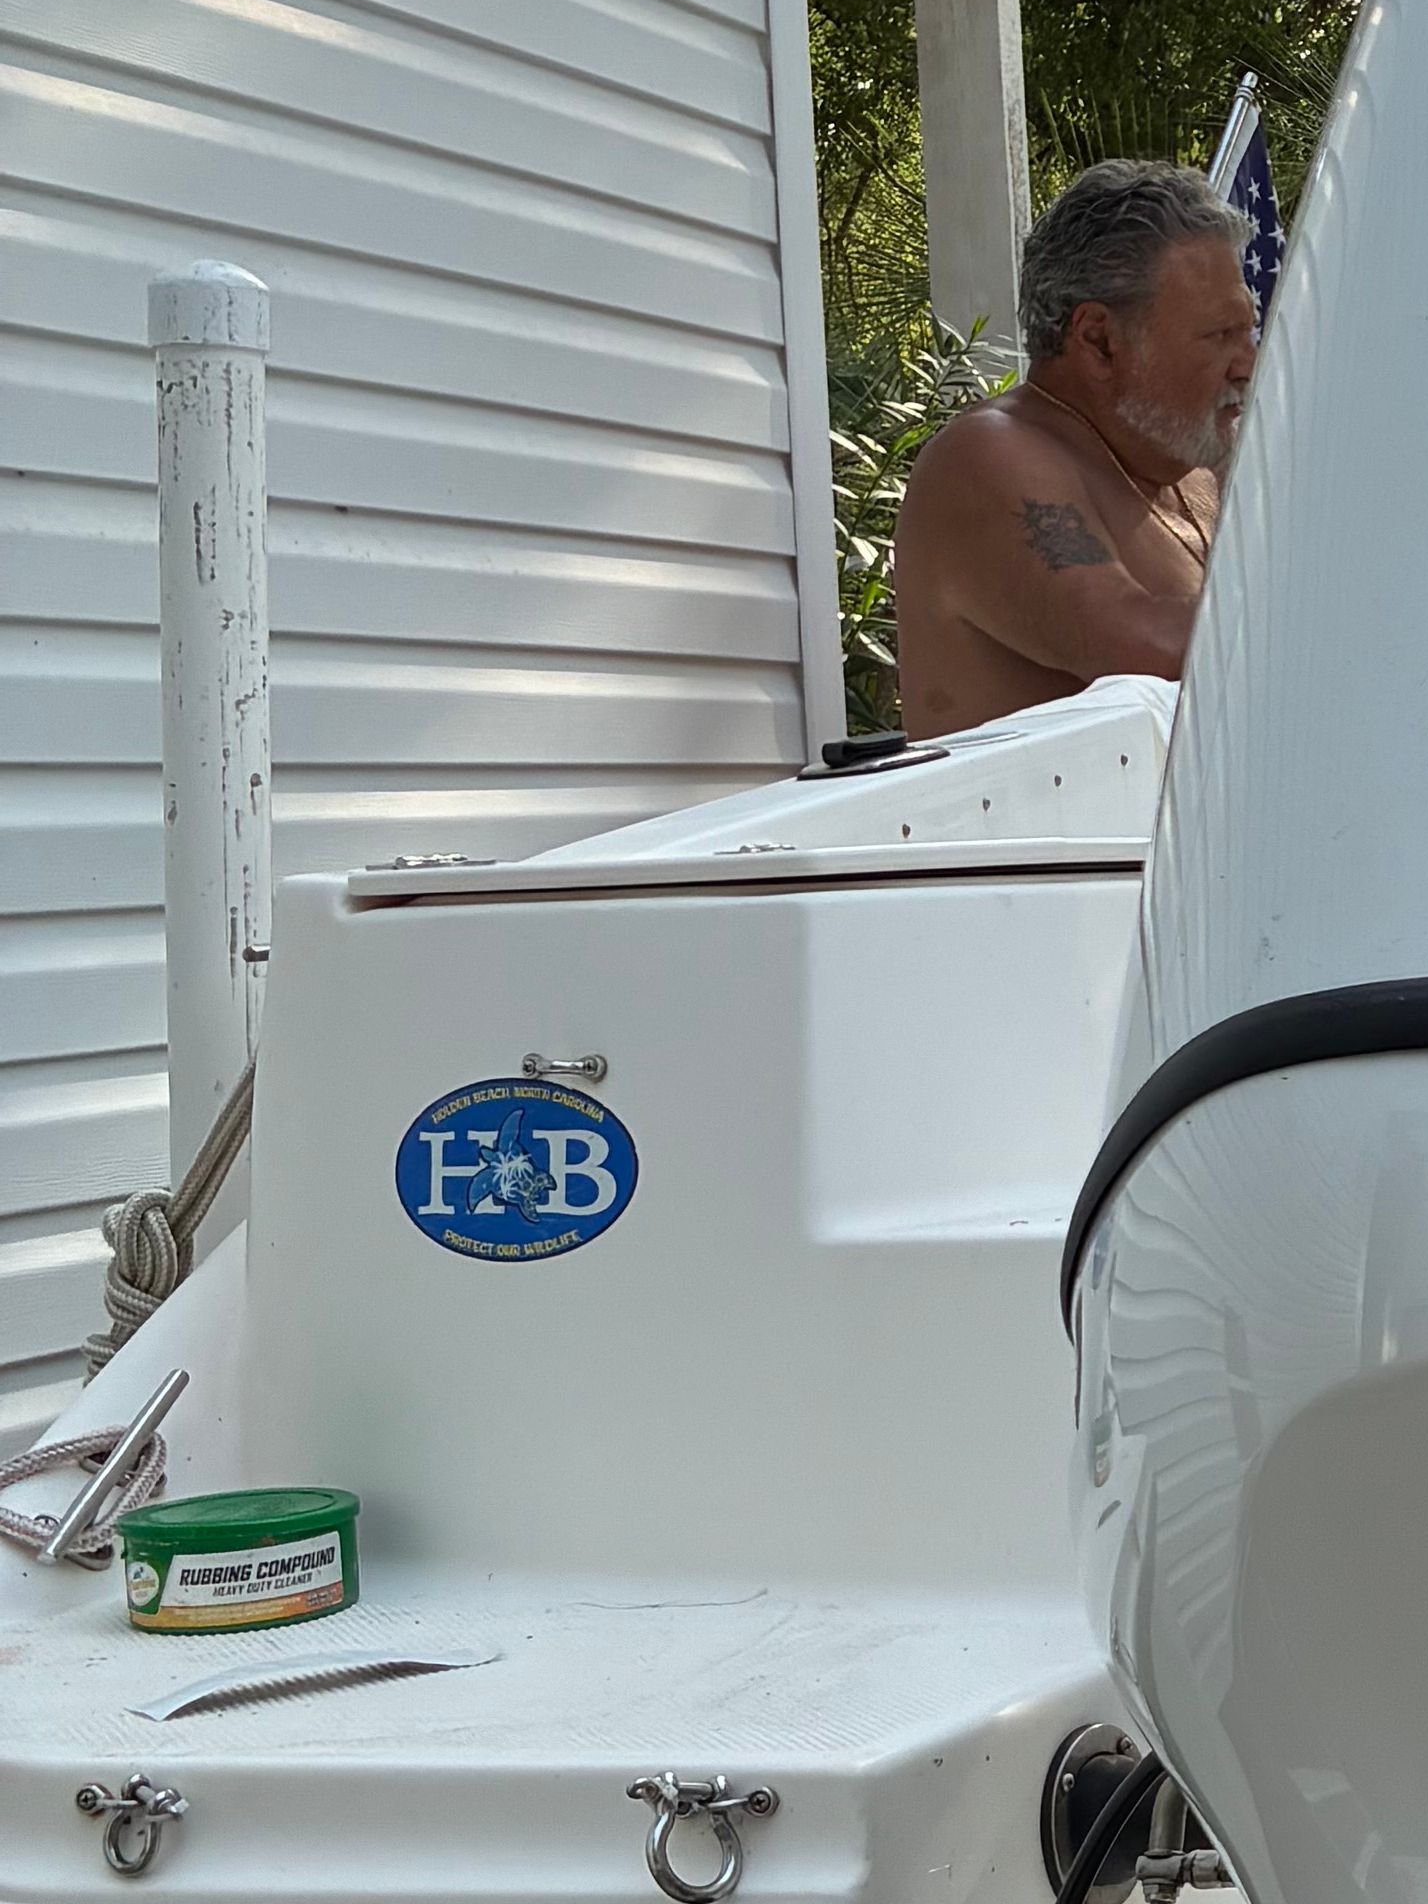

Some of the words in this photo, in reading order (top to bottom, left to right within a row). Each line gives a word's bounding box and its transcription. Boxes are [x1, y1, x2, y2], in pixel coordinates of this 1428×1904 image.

[473, 1087, 511, 1105] BEACH
[513, 1086, 550, 1101] NORTH
[552, 1091, 605, 1124] CAROLINA
[443, 1228, 495, 1256] PROTECT
[496, 1243, 521, 1257] OUR
[523, 1228, 583, 1257] WILDLIFE
[179, 1563, 253, 1587] RUBBING
[256, 1545, 336, 1580] COMPOUND
[212, 1584, 246, 1598] HEAVY
[246, 1580, 272, 1595] DUTY
[273, 1572, 313, 1590] CLEANER
